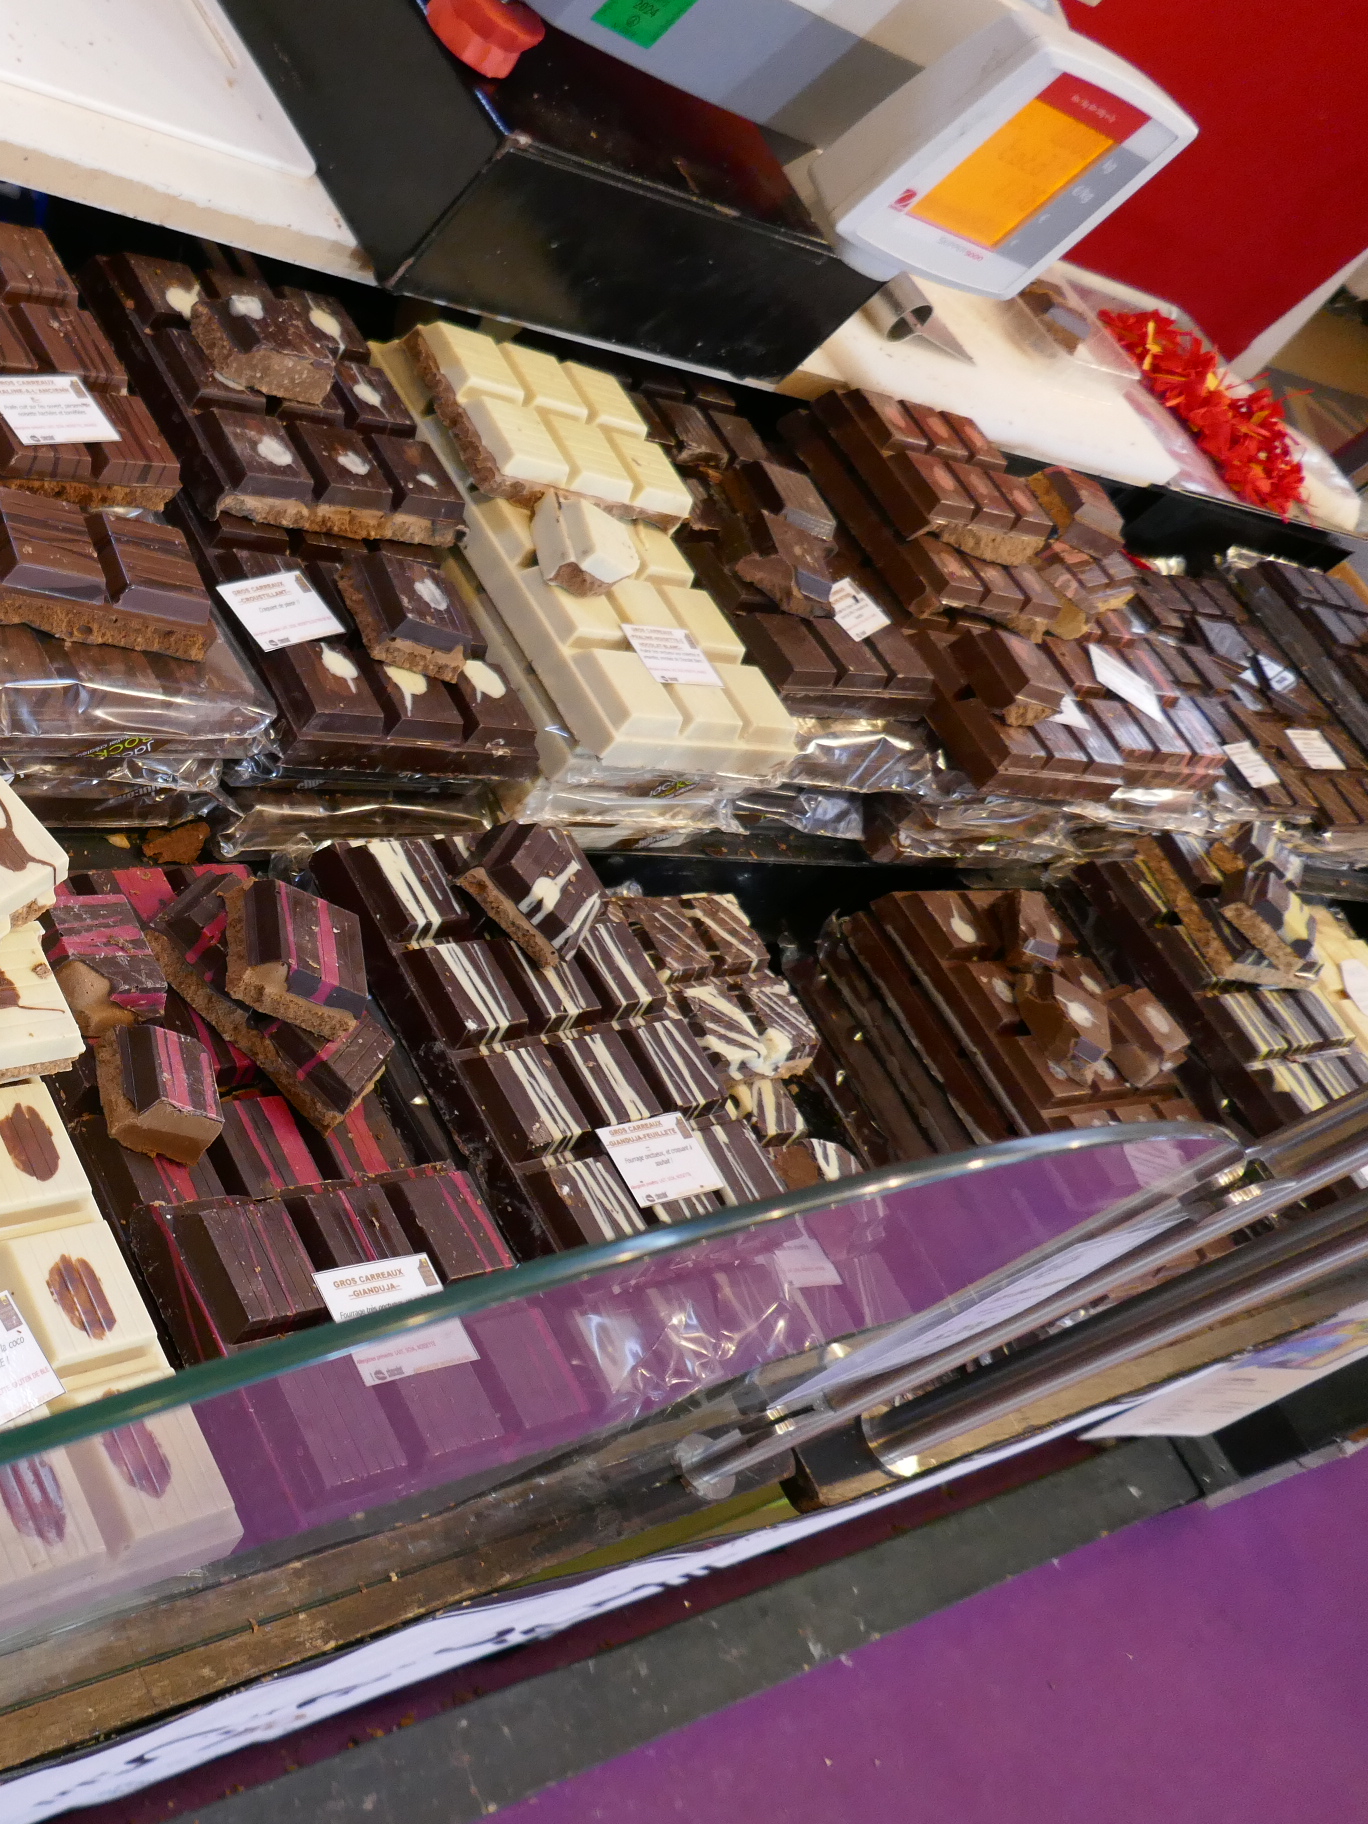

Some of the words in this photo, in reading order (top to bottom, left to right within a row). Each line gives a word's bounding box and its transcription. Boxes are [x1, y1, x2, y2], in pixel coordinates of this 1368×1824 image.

[333, 1277, 358, 1289] GROS
[358, 1269, 404, 1283] CARREAUX
[0, 1343, 8, 1353] la
[8, 1336, 26, 1349] coco
